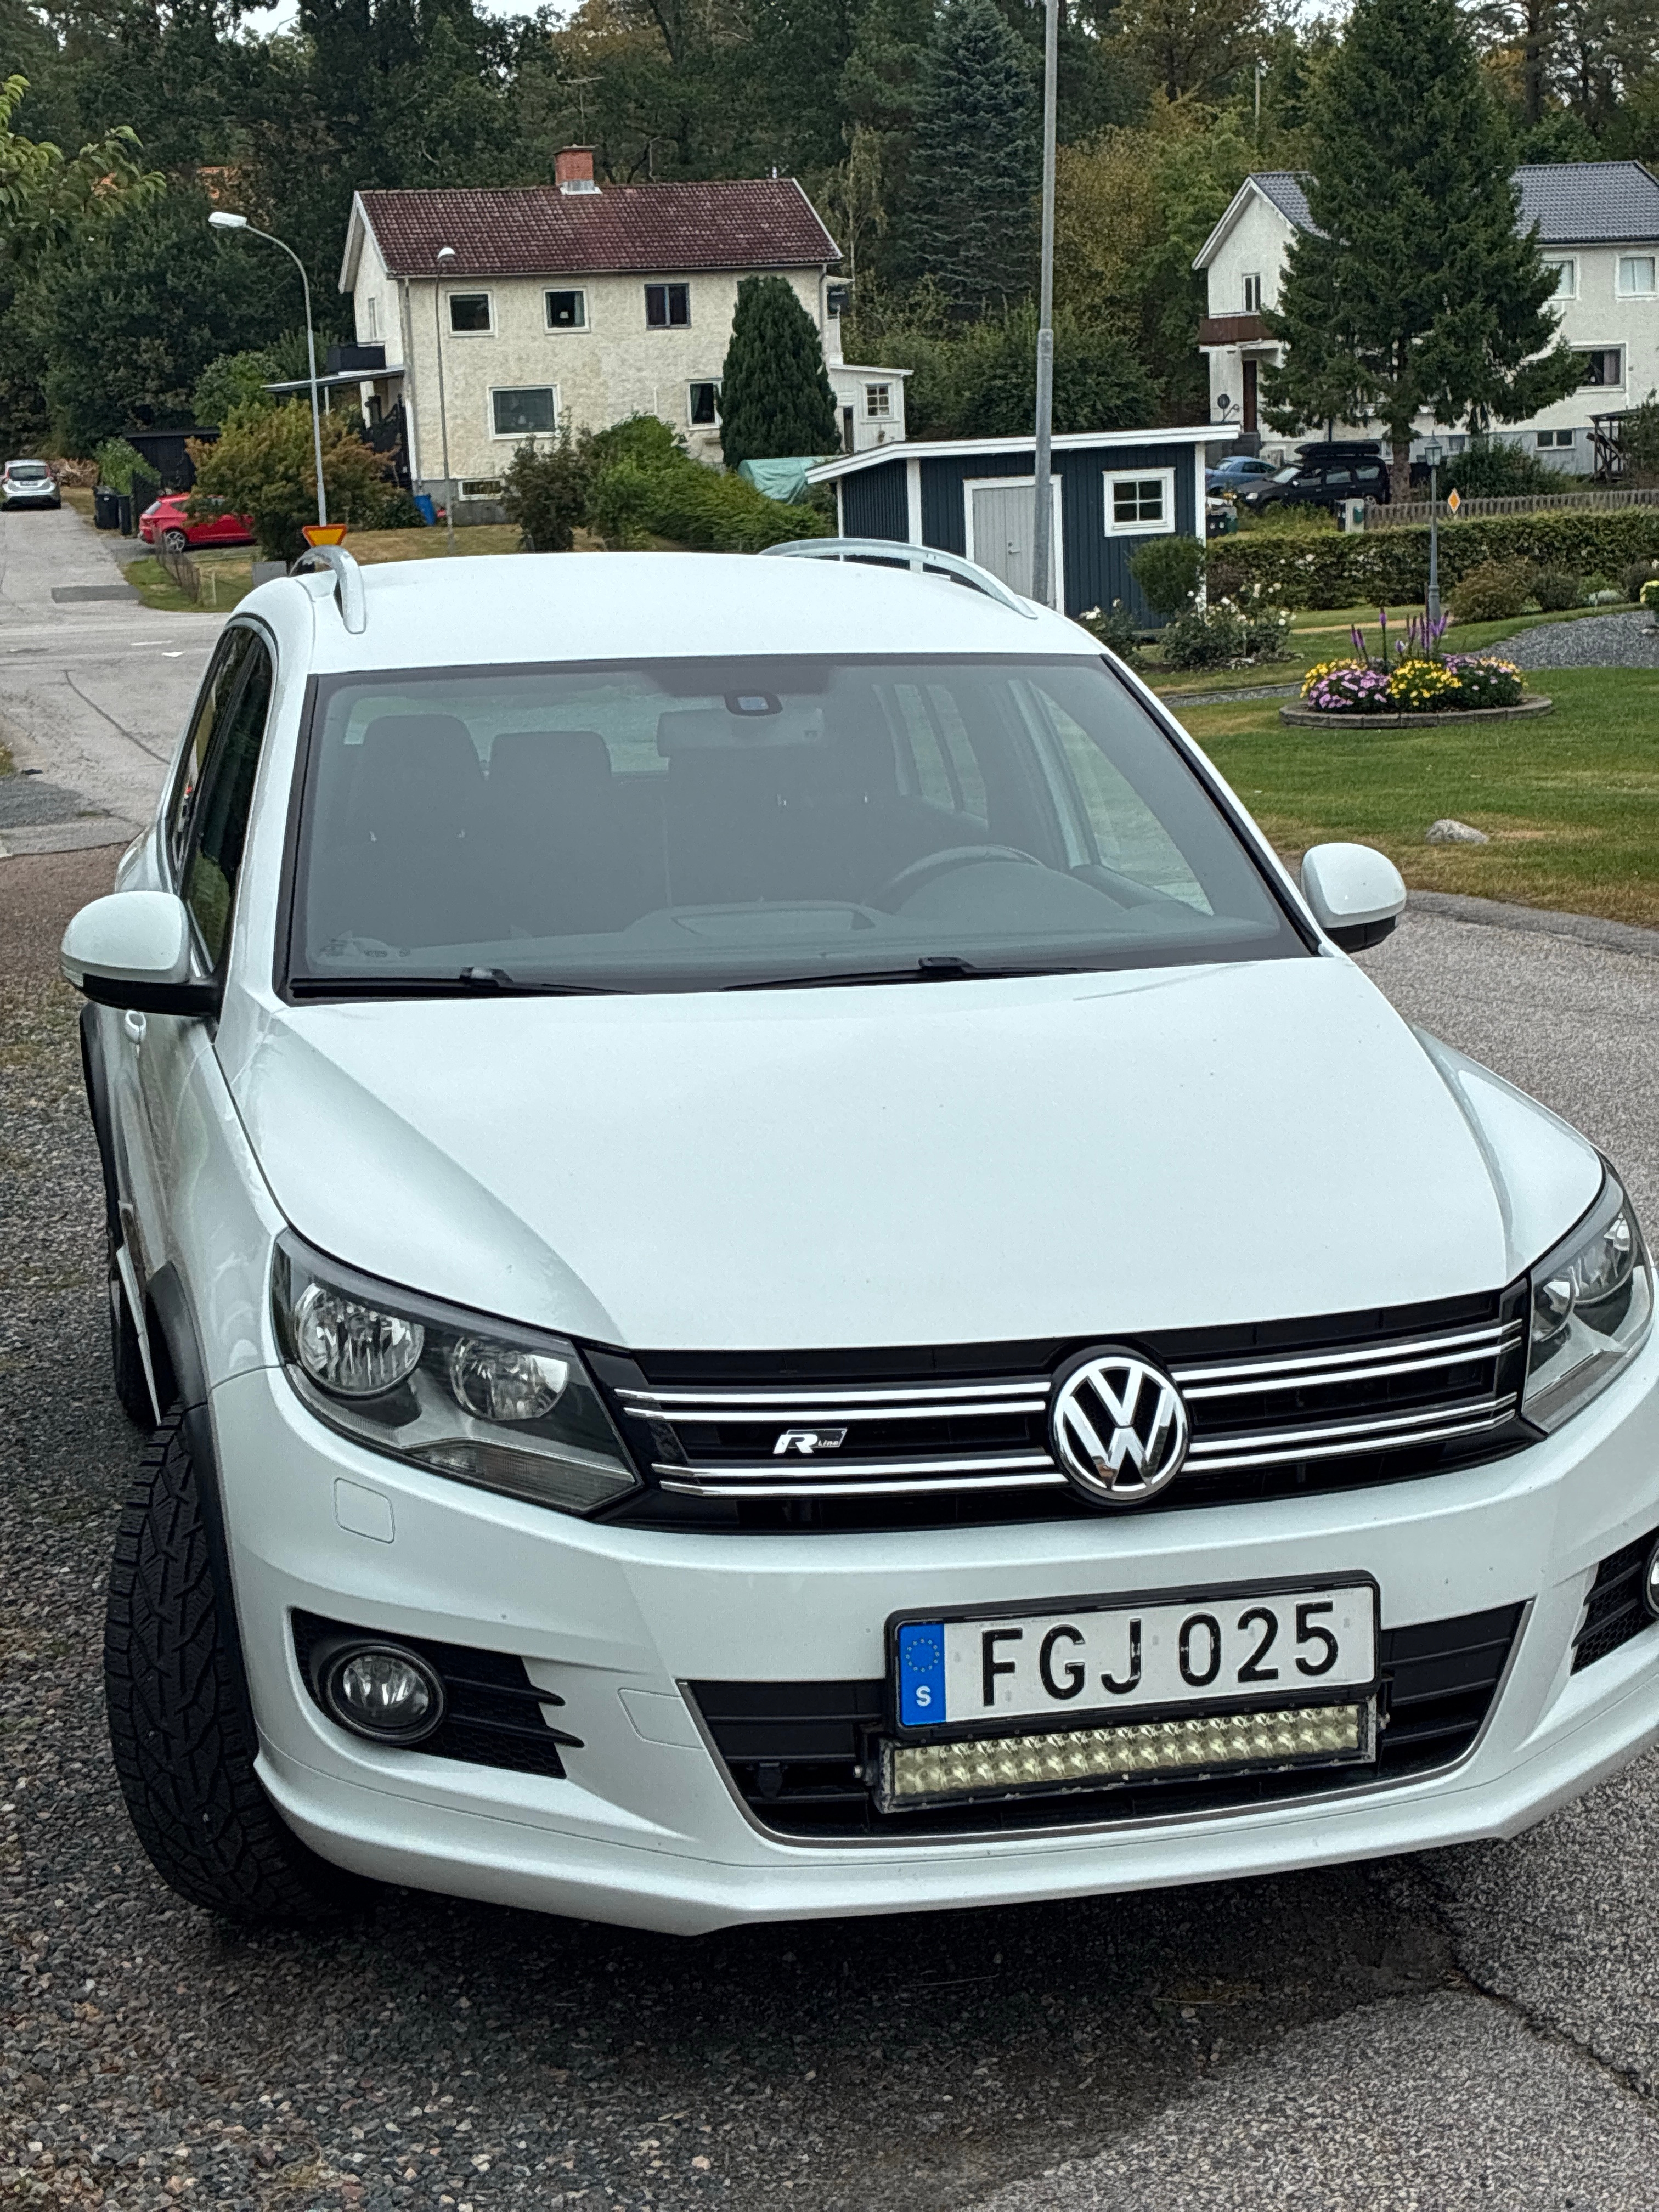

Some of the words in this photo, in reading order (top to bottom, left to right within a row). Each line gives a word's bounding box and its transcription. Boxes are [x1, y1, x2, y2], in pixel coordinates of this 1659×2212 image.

[773, 1434, 818, 1454] R
[1054, 1358, 1187, 1499] VW
[982, 1618, 1142, 1706] FGJ
[1178, 1600, 1339, 1687] 025
[916, 1686, 932, 1707] S
